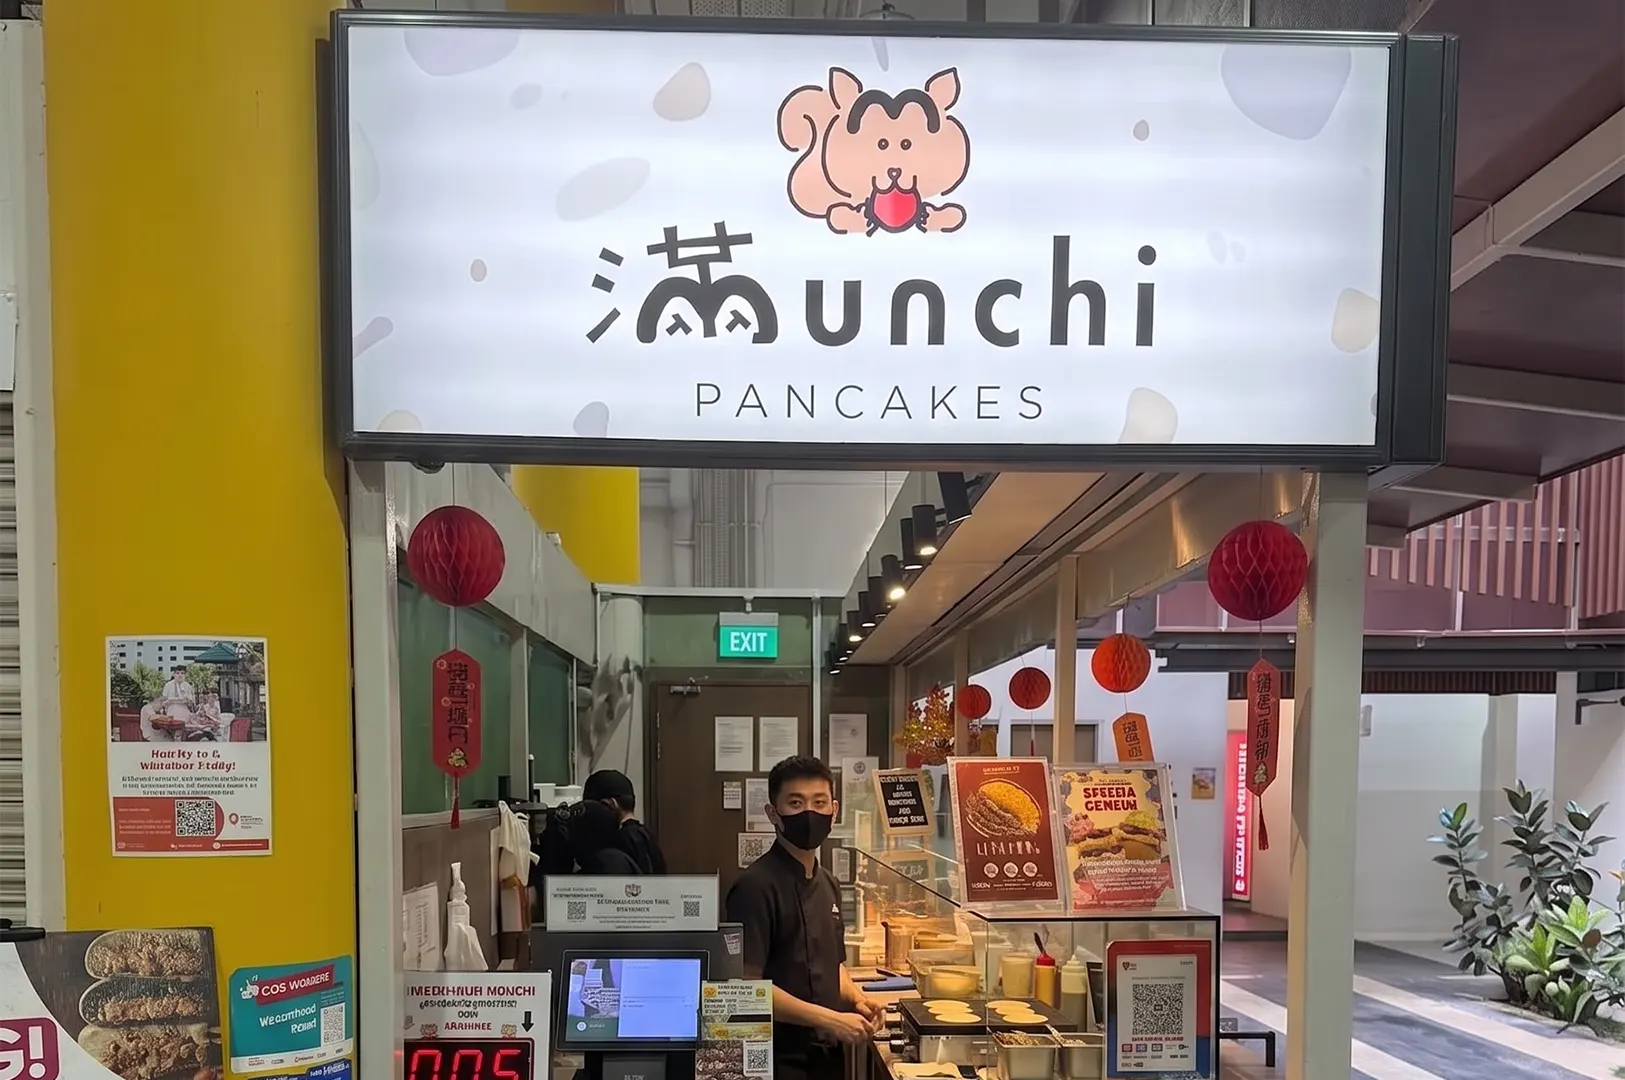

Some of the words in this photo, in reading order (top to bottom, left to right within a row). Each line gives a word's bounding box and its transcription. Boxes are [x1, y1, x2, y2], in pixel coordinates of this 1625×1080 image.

[696, 383, 1043, 419] PANCAKES
[730, 632, 767, 652] EXIT
[261, 982, 287, 996] COS
